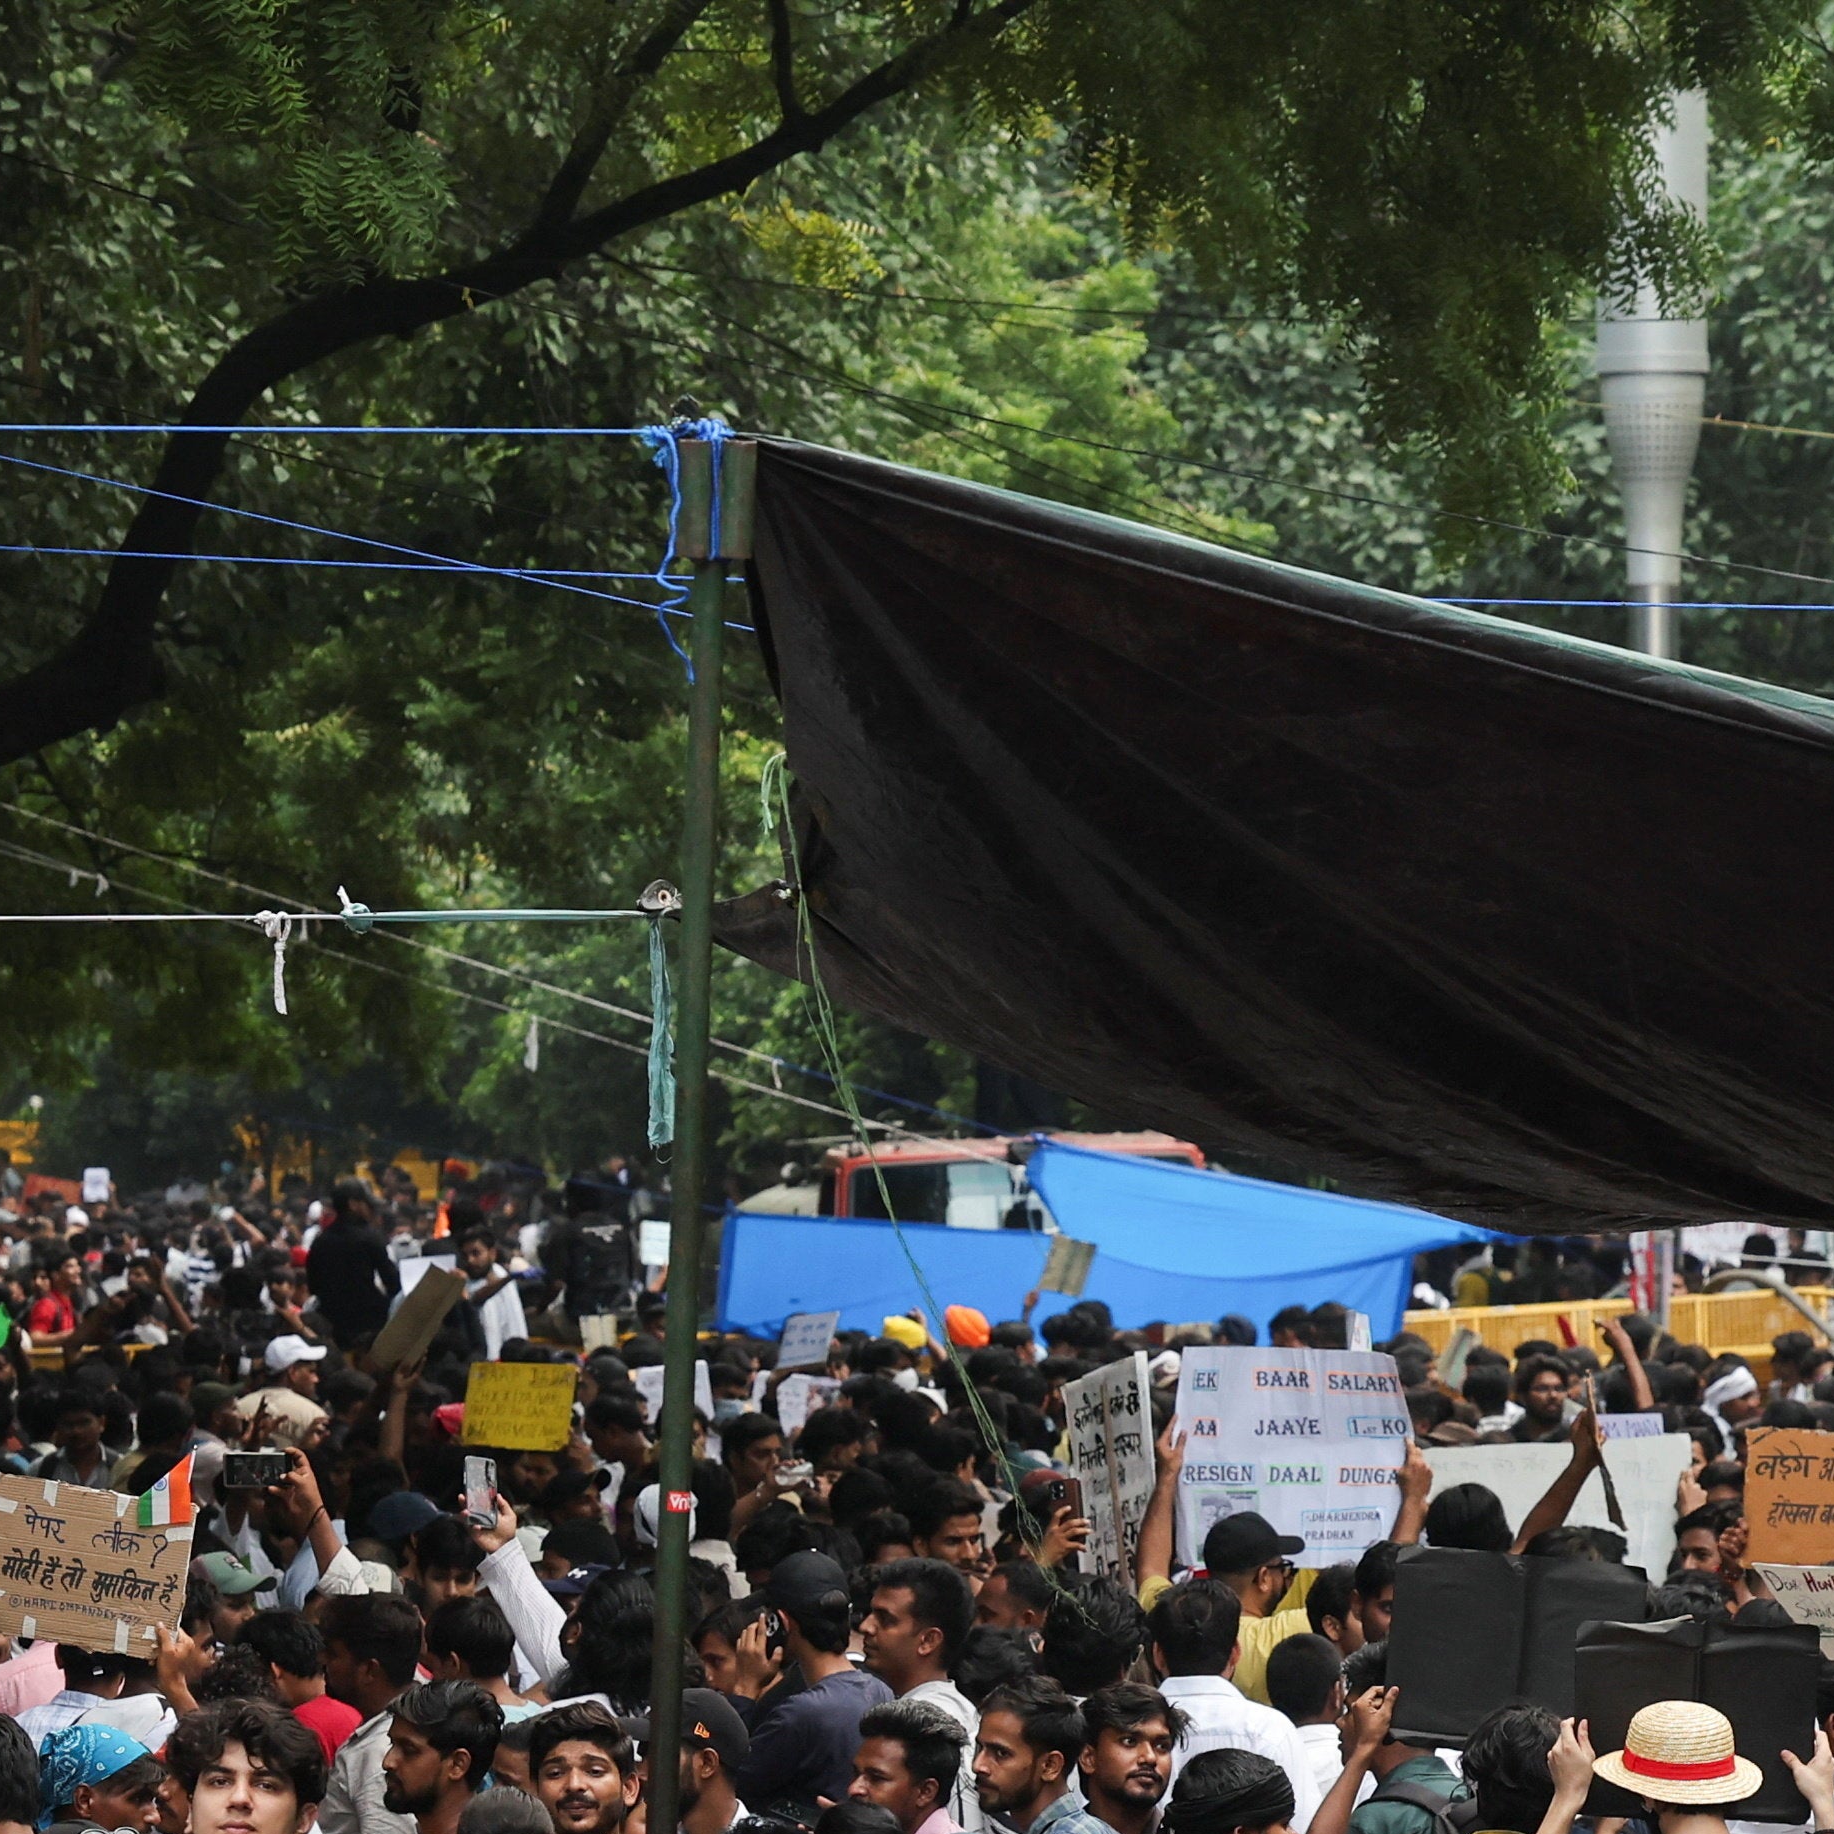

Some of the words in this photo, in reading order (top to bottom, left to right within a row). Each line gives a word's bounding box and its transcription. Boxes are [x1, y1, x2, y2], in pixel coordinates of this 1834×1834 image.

[1196, 1372, 1217, 1389] EK
[1256, 1371, 1309, 1389] BAAR
[1328, 1374, 1399, 1393] SALARY
[1194, 1419, 1217, 1436] AA
[1254, 1417, 1321, 1436] JAAYE
[1185, 1464, 1253, 1482] RESIGN
[1270, 1466, 1321, 1483] DAAL
[1339, 1468, 1400, 1484] DUNGA
[25, 1504, 66, 1543] पेपर
[91, 1522, 146, 1556] लीक
[1305, 1530, 1354, 1540] PRADHAN
[2, 1547, 43, 1585] मोदी
[40, 1556, 62, 1590] है
[60, 1558, 86, 1591] तो
[90, 1568, 159, 1602] मुमकिन
[158, 1573, 178, 1611] है
